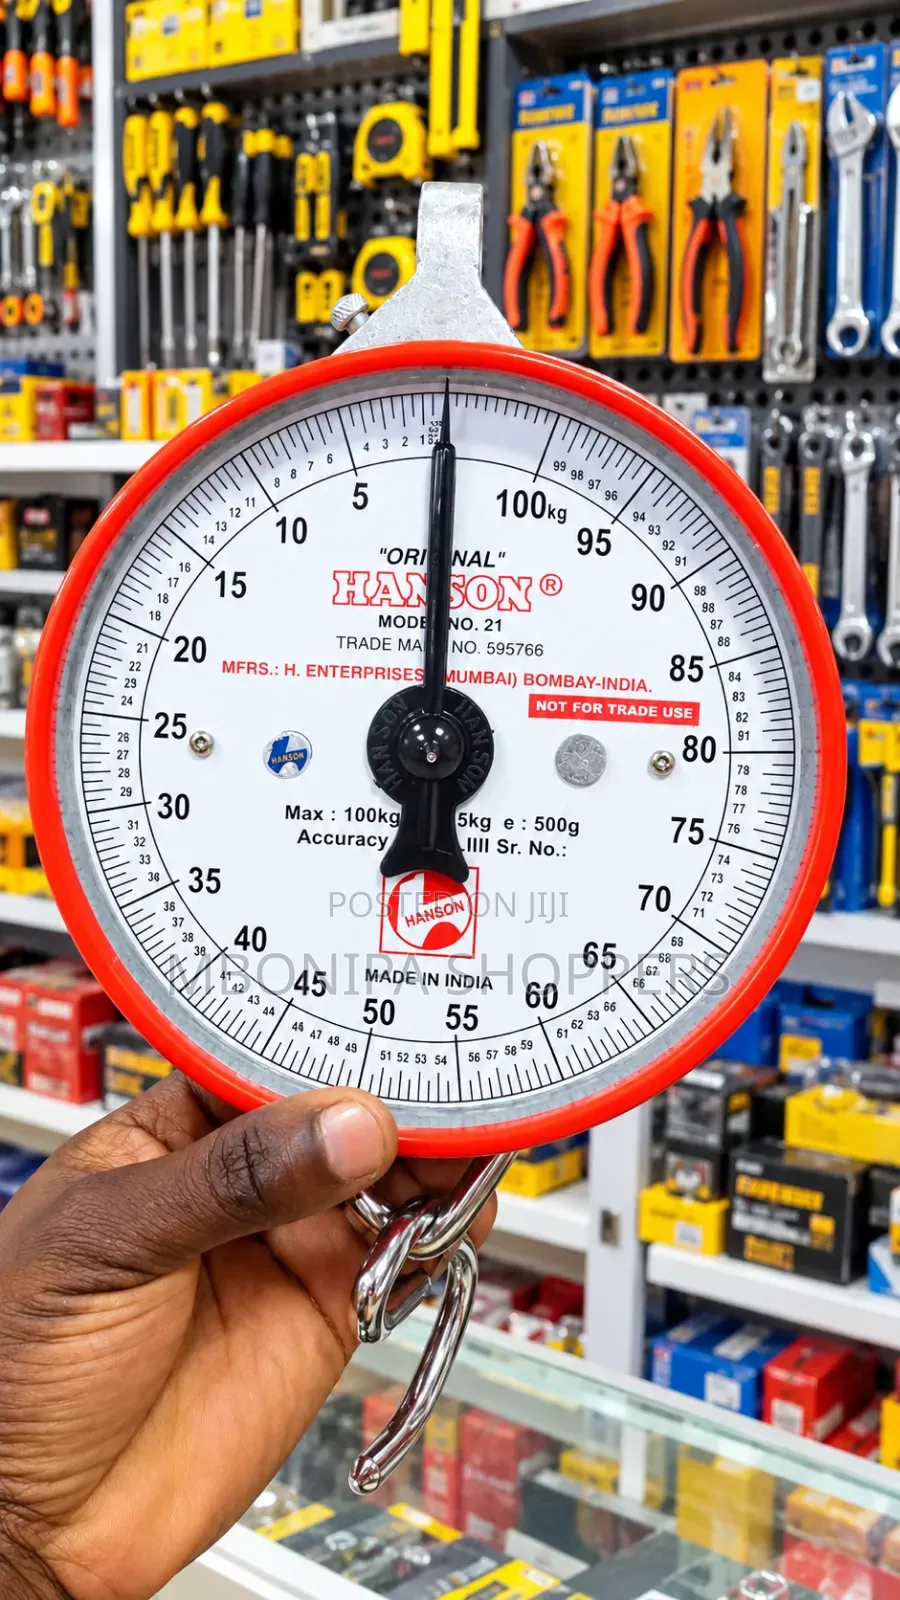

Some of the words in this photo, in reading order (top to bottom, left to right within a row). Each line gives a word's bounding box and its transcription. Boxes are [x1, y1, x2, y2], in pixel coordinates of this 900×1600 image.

[382, 438, 389, 449] 3
[402, 436, 409, 447] 2
[420, 434, 425, 445] 1
[363, 442, 370, 452] 4
[326, 453, 333, 464] 6
[308, 461, 314, 471] 7
[553, 461, 567, 472] 99
[290, 469, 297, 479] 8
[570, 470, 584, 481] 98
[588, 479, 601, 490] 97
[352, 482, 369, 510] 5
[604, 489, 618, 501] 96
[245, 497, 256, 507] 11
[229, 507, 241, 518] 12
[632, 511, 646, 523] 94
[215, 521, 227, 532] 13
[275, 516, 307, 544] 10
[648, 524, 661, 536] 93
[203, 535, 215, 545] 14
[577, 527, 612, 556] 95
[662, 540, 676, 551] 92
[380, 547, 506, 568] "ORINAL"
[674, 556, 687, 567] 91
[179, 562, 191, 573] 16
[168, 577, 179, 588] 17
[214, 570, 247, 598] 15
[158, 593, 169, 604] 18
[631, 583, 665, 612] 90
[149, 611, 161, 621] 18
[378, 614, 427, 630] MODE
[448, 617, 478, 632] NO.
[484, 618, 502, 632] 21
[136, 642, 148, 654] 21
[173, 635, 207, 663] 20
[336, 635, 392, 651] TRADE
[398, 638, 425, 652] MA
[452, 640, 481, 655] NO.
[487, 642, 544, 657] 595766
[129, 661, 141, 672] 22
[669, 654, 704, 683] 85
[222, 660, 279, 676] MFRS.:
[284, 663, 300, 677] H.
[306, 664, 425, 682] ENTERPRISES
[445, 669, 517, 689] MUMBAI)
[523, 674, 653, 693] BOMBAY-INDIA.
[728, 671, 742, 683] 84
[121, 696, 133, 706] 24
[732, 691, 746, 703] 83
[536, 700, 567, 713] NOT
[572, 702, 602, 715] FOR
[607, 704, 658, 717] TRADE
[662, 707, 693, 719] USE
[735, 711, 749, 723] 82
[154, 712, 187, 739] 25
[682, 734, 716, 763] 80
[116, 750, 129, 760] 27
[157, 793, 190, 820] 30
[732, 803, 746, 814] 77
[285, 805, 324, 821] Max
[344, 807, 400, 828] 100kg
[127, 820, 139, 831] 31
[503, 818, 514, 830] e
[534, 816, 580, 837] 500g
[671, 816, 704, 845] 75
[727, 823, 741, 835] 76
[133, 836, 146, 847] 32
[297, 829, 389, 851] Accuracy
[497, 839, 521, 855] Sr.
[139, 854, 151, 865] 33
[717, 854, 730, 866] 74
[188, 866, 221, 894] 35
[711, 873, 724, 884] 73
[638, 884, 671, 912] 70
[701, 891, 714, 903] 72
[404, 900, 465, 928] HANSON
[692, 907, 705, 918] 71
[172, 917, 184, 928] 37
[181, 932, 194, 943] 38
[234, 925, 267, 952] 40
[582, 941, 617, 970] 65
[219, 970, 231, 981] 41
[365, 968, 417, 985] MADE
[422, 973, 439, 986] IN
[445, 973, 493, 990] INDIA
[293, 970, 327, 997] 45
[632, 977, 645, 989] 66
[247, 995, 260, 1005] 43
[525, 981, 558, 1009] 60
[262, 1006, 275, 1016] 44
[363, 998, 395, 1026] 50
[445, 1003, 479, 1031] 55
[309, 1029, 322, 1040] 47
[327, 1035, 340, 1046] 48
[380, 1050, 392, 1061] 51
[486, 1049, 499, 1060] 57
[504, 1045, 517, 1056] 58
[396, 1052, 409, 1063] 52
[414, 1053, 427, 1064] 53
[434, 1054, 447, 1066] 54
[468, 1051, 481, 1063] 56
